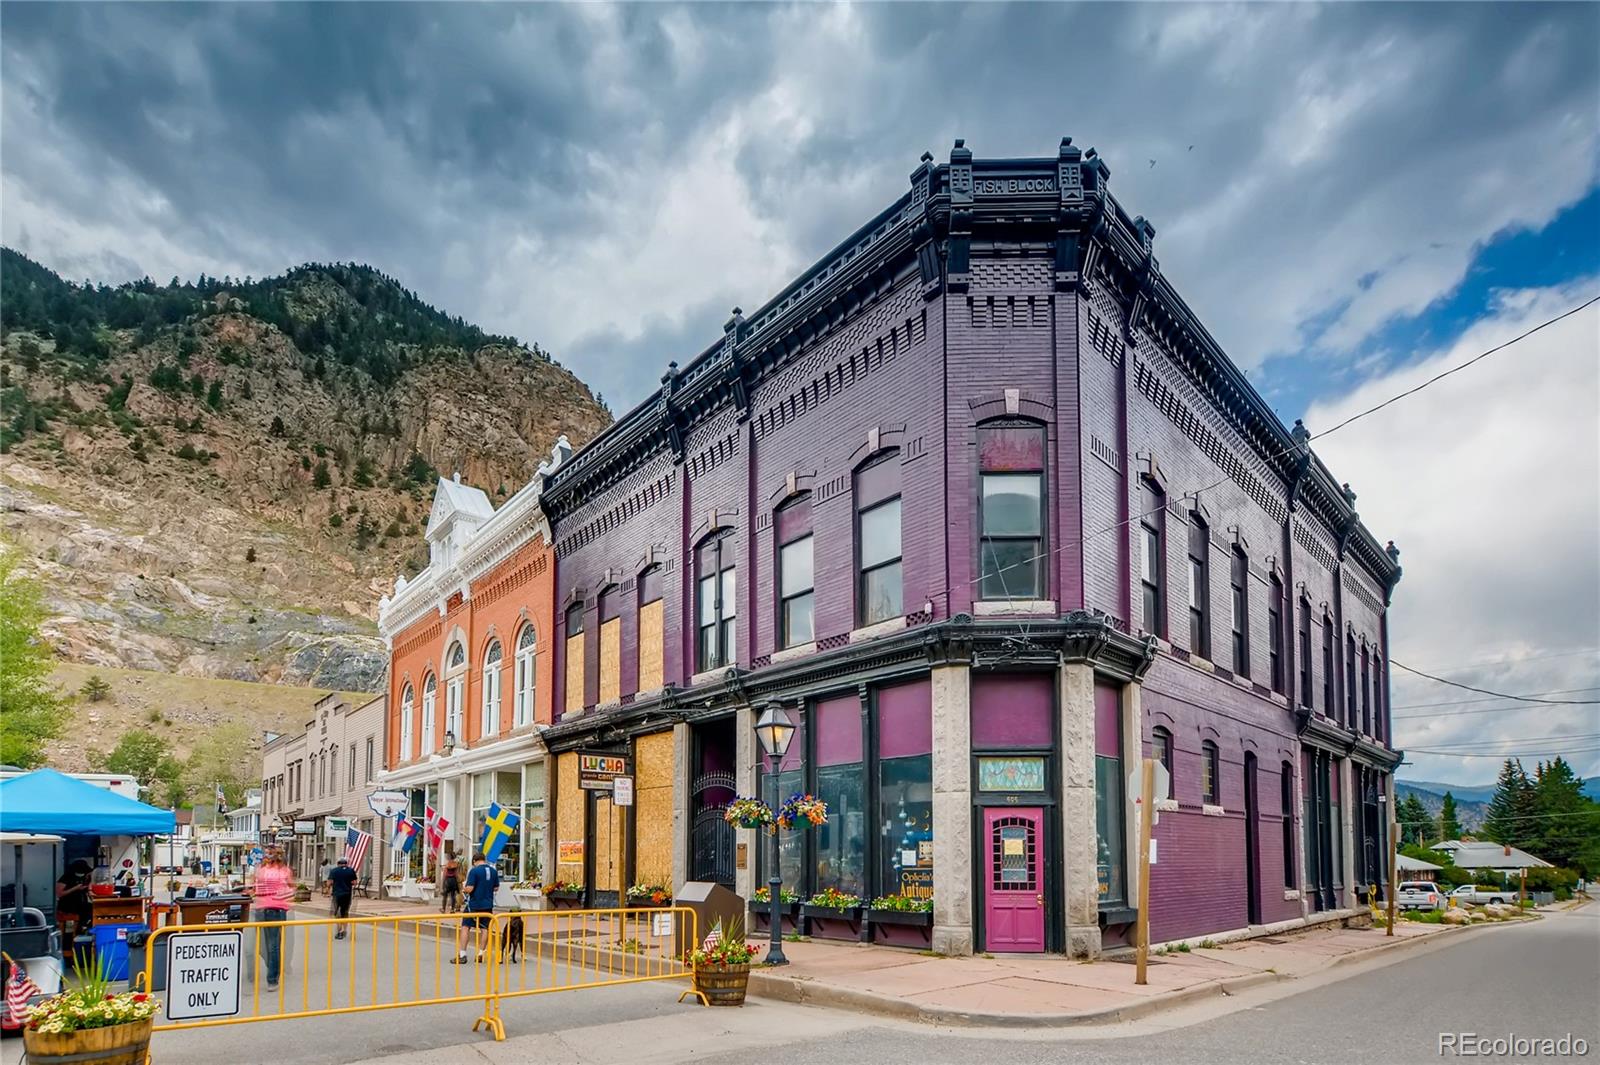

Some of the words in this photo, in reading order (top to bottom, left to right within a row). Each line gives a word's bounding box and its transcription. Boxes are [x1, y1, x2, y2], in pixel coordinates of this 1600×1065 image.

[973, 180, 1003, 194] FISH
[1008, 178, 1054, 193] BLOCK
[582, 757, 623, 772] LUCHA
[175, 944, 235, 960] PEDESTRIAN
[180, 967, 229, 984] TRAFFIC
[188, 991, 220, 1008] ONLY
